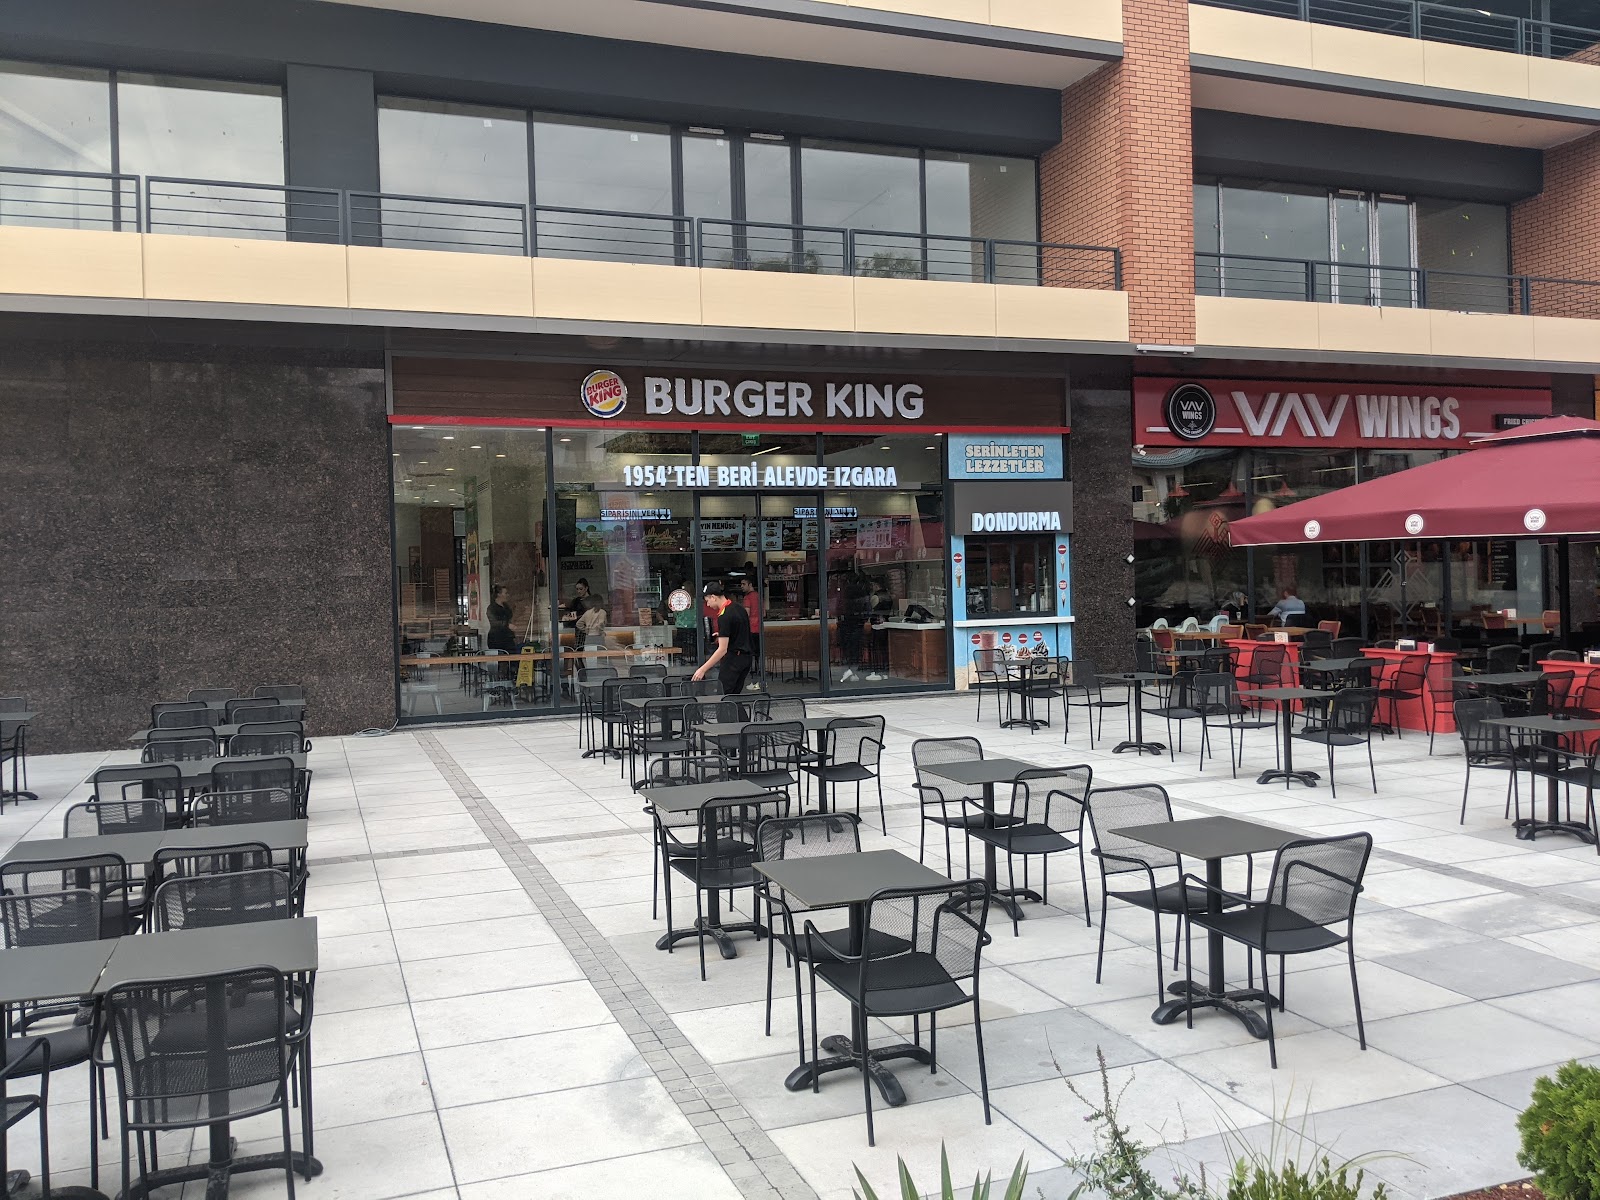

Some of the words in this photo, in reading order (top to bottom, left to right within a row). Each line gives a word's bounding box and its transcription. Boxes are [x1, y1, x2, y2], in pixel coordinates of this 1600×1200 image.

[586, 378, 619, 395] BURGER
[589, 385, 622, 407] KING
[645, 376, 813, 418] BURGER
[826, 383, 924, 419] KING
[1182, 411, 1203, 420] WINGS
[1230, 391, 1350, 438] VAV
[1355, 394, 1461, 440] WINGS
[965, 441, 1045, 458] SERİNLETEN
[623, 465, 710, 488] 1954'TEN
[718, 461, 758, 488] BERİ
[764, 466, 828, 488] ALEVDE
[834, 467, 898, 488] IZGARA
[965, 459, 1045, 474] LEZZETLER
[971, 511, 1062, 533] DONDURMA
